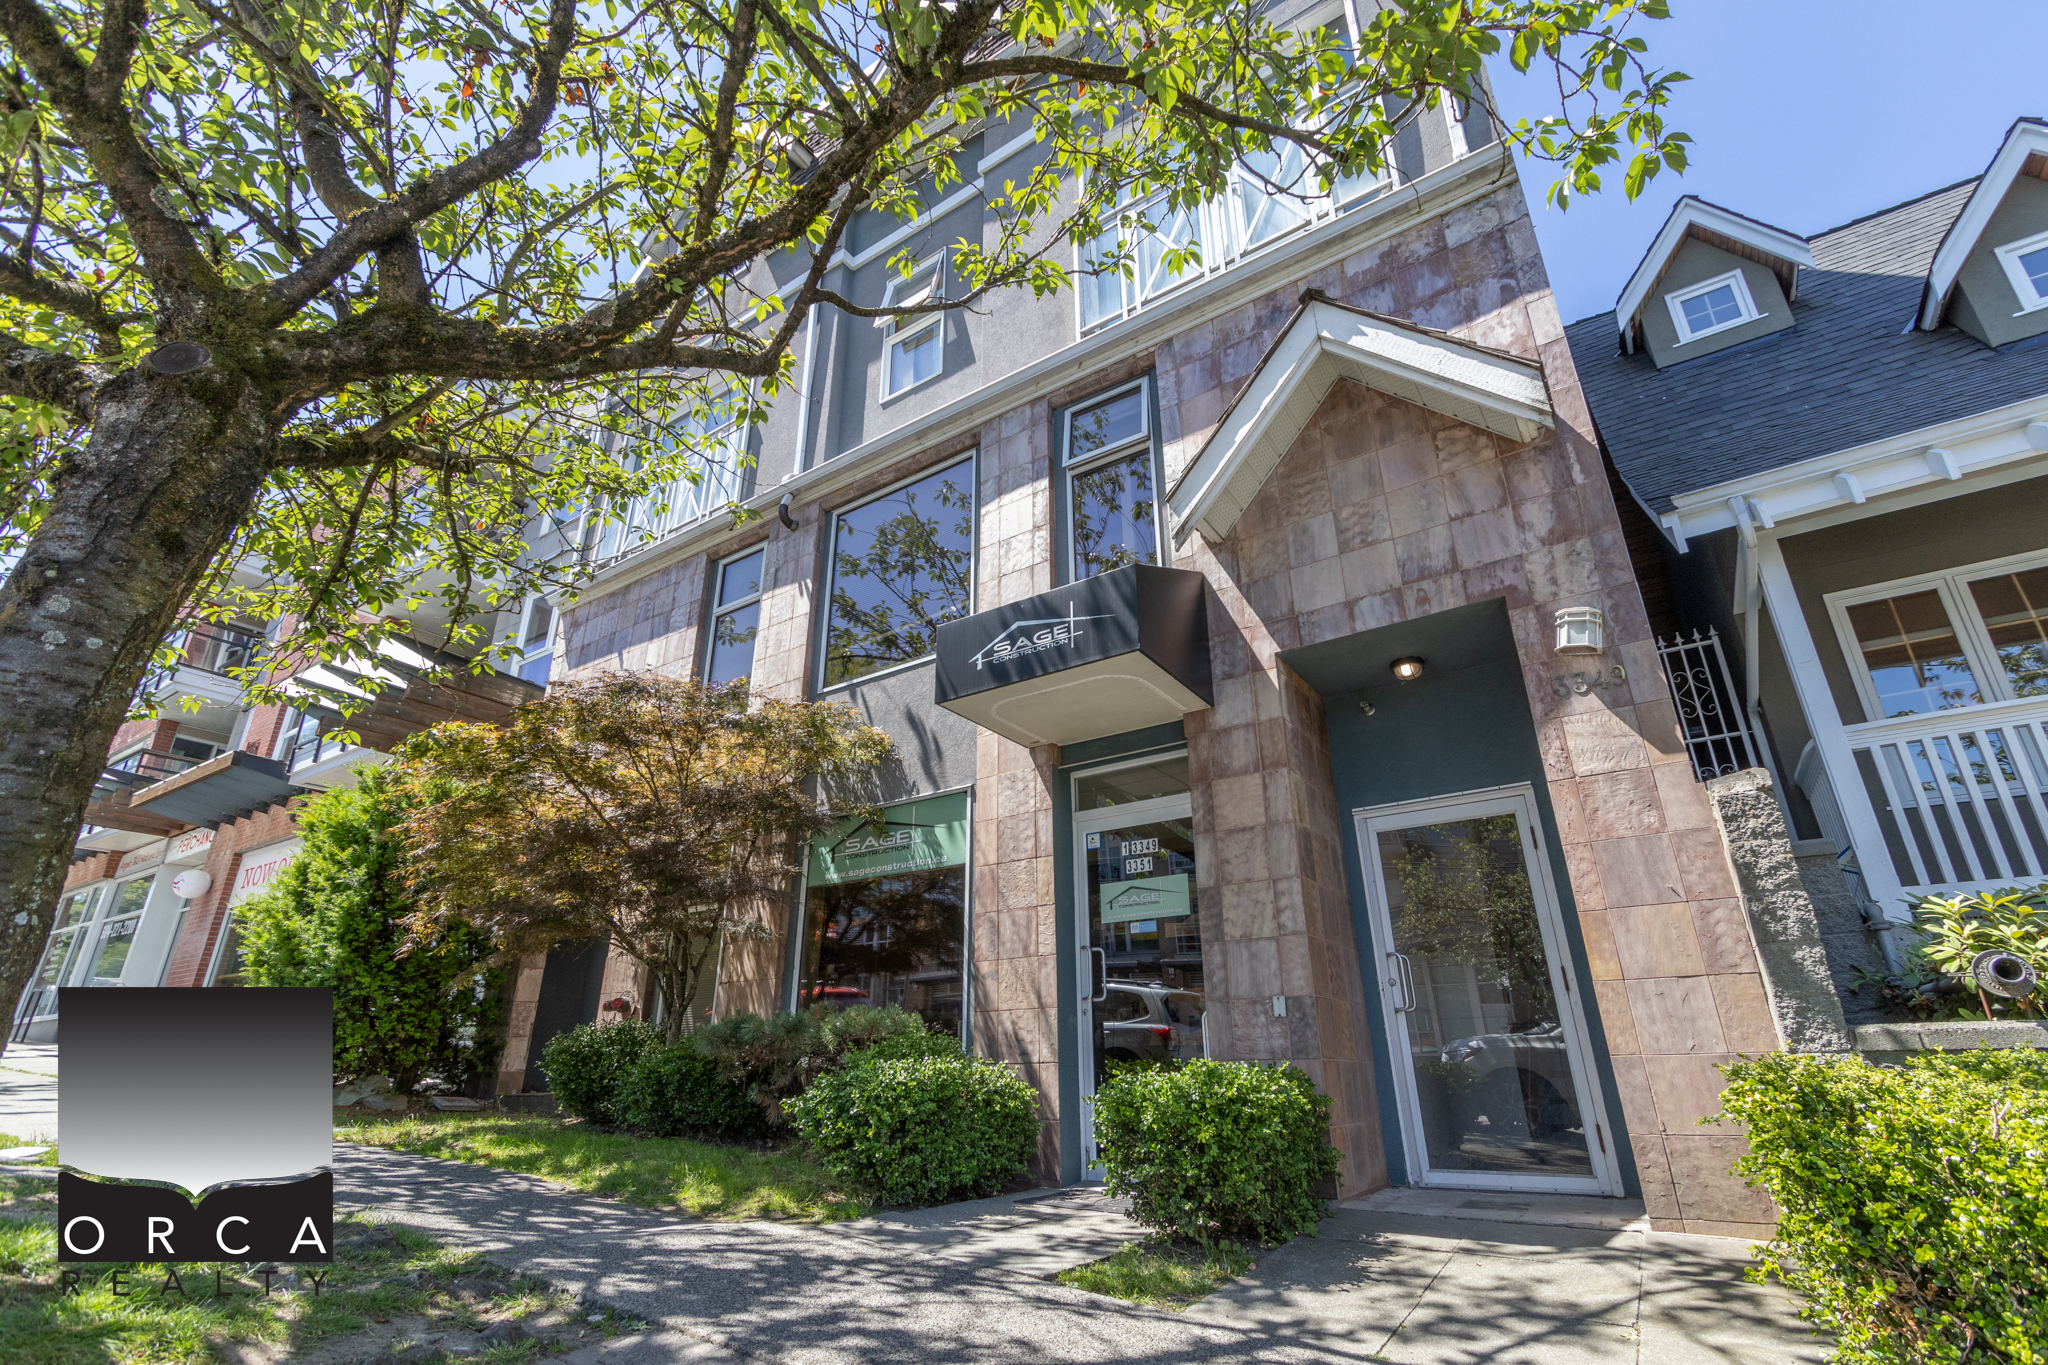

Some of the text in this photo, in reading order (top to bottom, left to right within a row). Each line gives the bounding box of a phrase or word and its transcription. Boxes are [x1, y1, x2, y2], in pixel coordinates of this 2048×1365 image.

[993, 623, 1069, 657] SAGE
[993, 637, 1068, 664] CONSTRUCTION
[1551, 665, 1626, 698] 3349
[844, 844, 910, 861] CONSTRUCTION
[845, 829, 911, 853] SAGE
[825, 855, 947, 879] www.sageconstruction.ca
[1127, 858, 1152, 873] 3351
[1118, 892, 1160, 905] SAGE
[1118, 900, 1160, 909] CONSTRUCTION
